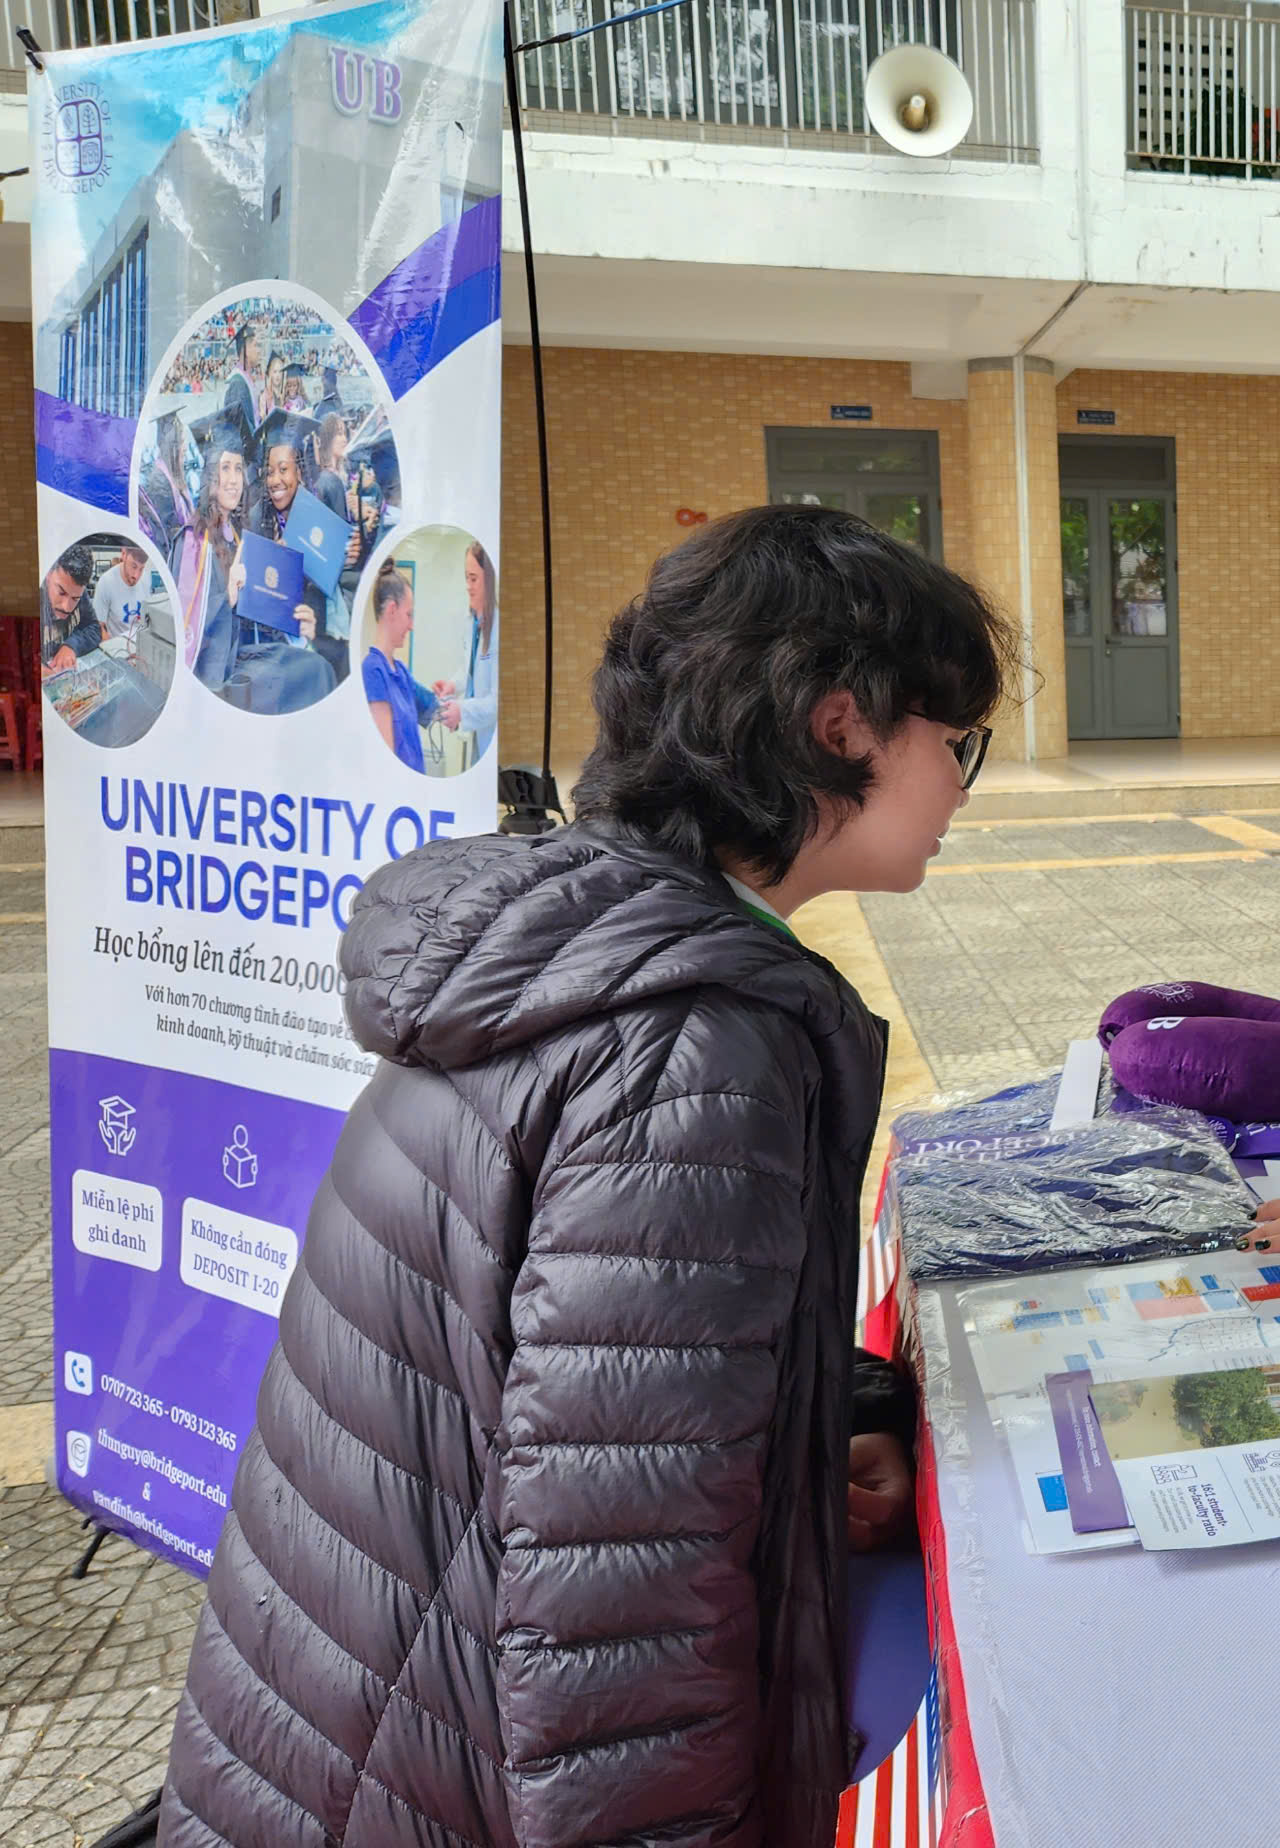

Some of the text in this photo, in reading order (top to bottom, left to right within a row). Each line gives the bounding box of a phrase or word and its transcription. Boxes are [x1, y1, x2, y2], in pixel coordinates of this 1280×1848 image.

[329, 46, 403, 124] UB
[100, 776, 376, 860] UNIVERSITY
[94, 926, 133, 962] Học
[138, 926, 188, 973] bổng
[193, 940, 224, 974] lên
[229, 942, 266, 981] đến
[145, 984, 164, 1003] Với
[166, 987, 190, 1007] hơn
[191, 993, 207, 1011] 70
[209, 996, 251, 1024] chương
[282, 1010, 305, 1031] đào
[156, 1014, 185, 1035] kinh
[187, 1020, 226, 1047] doanh,
[228, 1027, 242, 1050] kỹ
[243, 1032, 277, 1058] thuật
[278, 1040, 293, 1058] và
[294, 1043, 329, 1067] chăm
[331, 1051, 352, 1072] sóc
[82, 1189, 154, 1222] Miễn lệ phí
[88, 1223, 146, 1252] ghi danh
[191, 1218, 288, 1270] Không cần đóng
[193, 1253, 279, 1299] DEPOSIT I-20
[101, 1374, 125, 1398] 0707
[125, 1391, 142, 1409] 723
[142, 1396, 163, 1416] 365
[170, 1406, 198, 1433] 0793
[198, 1417, 216, 1440] 123
[216, 1424, 237, 1451] 365
[98, 1428, 227, 1508] thunguy@bridgeport.edu
[142, 1482, 151, 1502] &
[1187, 1485, 1217, 1537] to-faculty ratio
[1201, 1483, 1227, 1527] 16:1 student-
